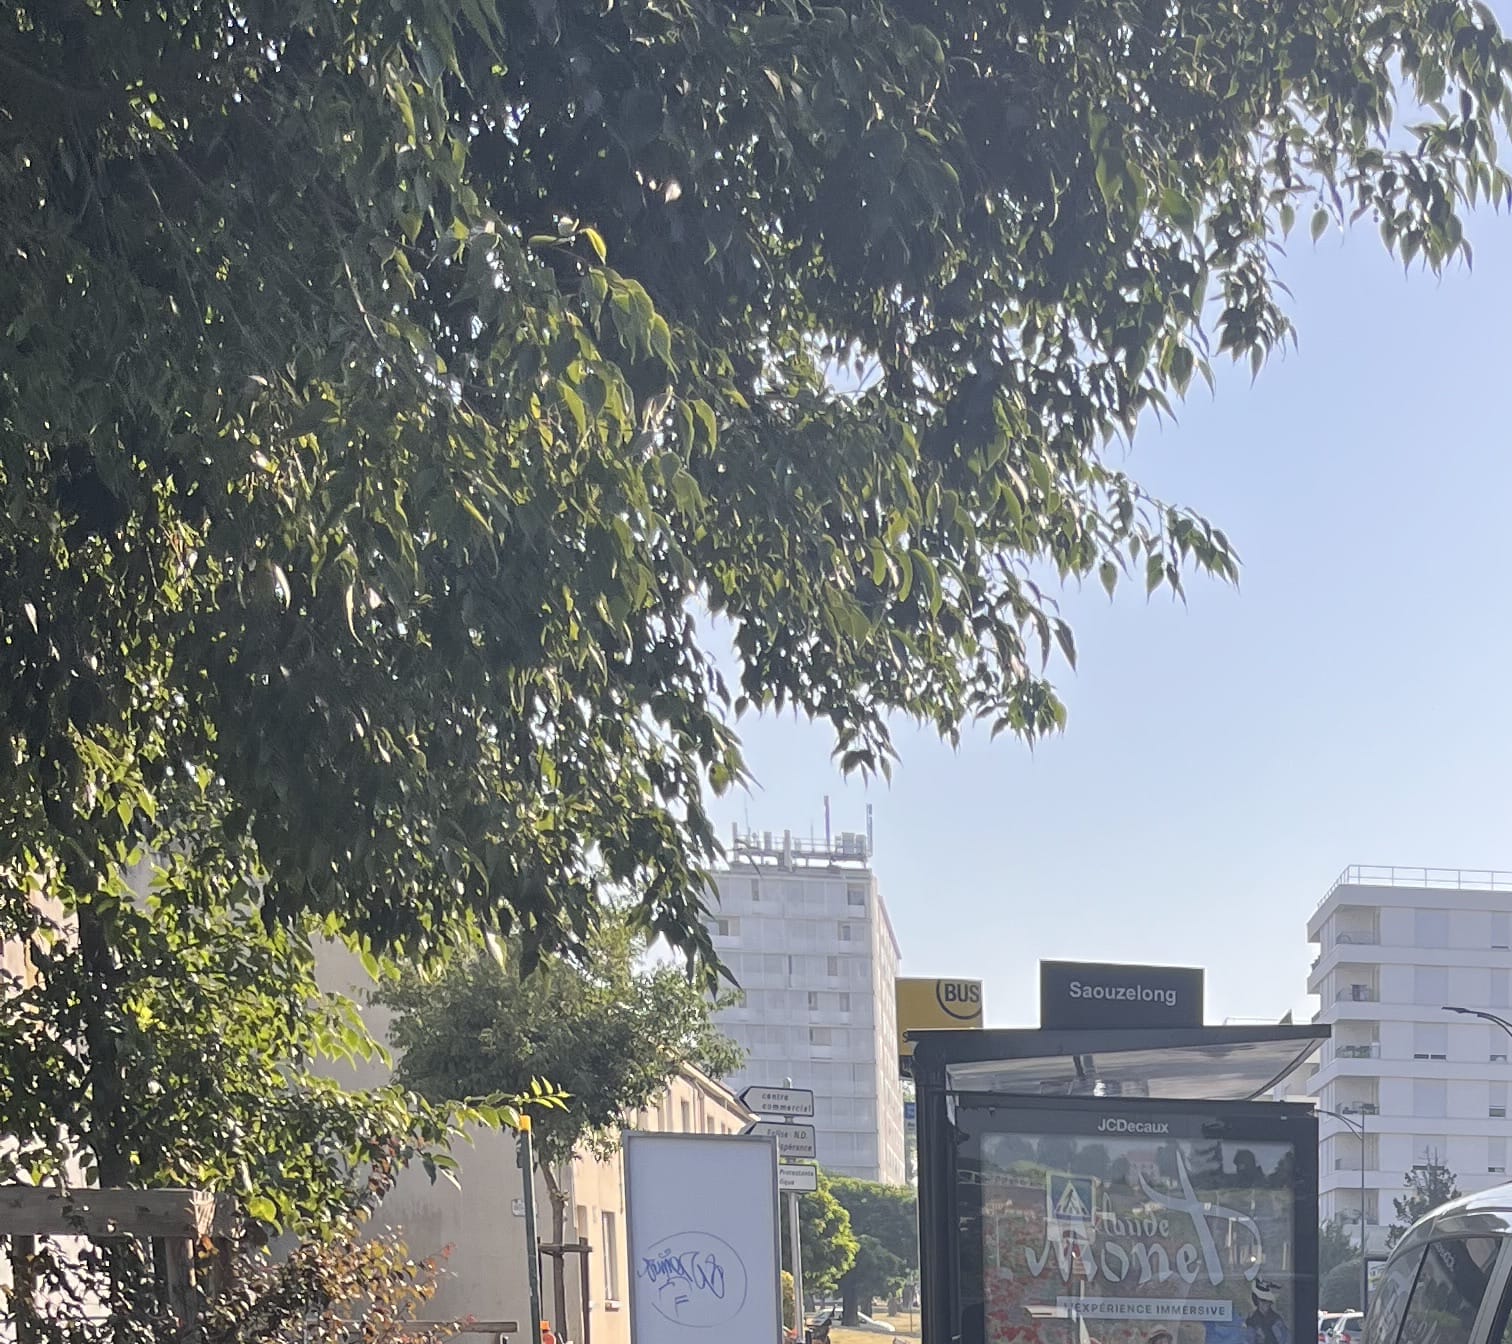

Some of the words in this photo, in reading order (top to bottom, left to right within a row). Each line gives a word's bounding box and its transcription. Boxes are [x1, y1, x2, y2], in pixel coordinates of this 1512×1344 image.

[944, 983, 980, 1003] BUS
[1069, 981, 1177, 1006] Saouzelong
[762, 1093, 789, 1101] centre
[762, 1103, 811, 1113] commercial
[1097, 1118, 1169, 1134] JCDecaux
[780, 1144, 812, 1152] spérance
[1156, 1304, 1225, 1316] IMMERSIVE
